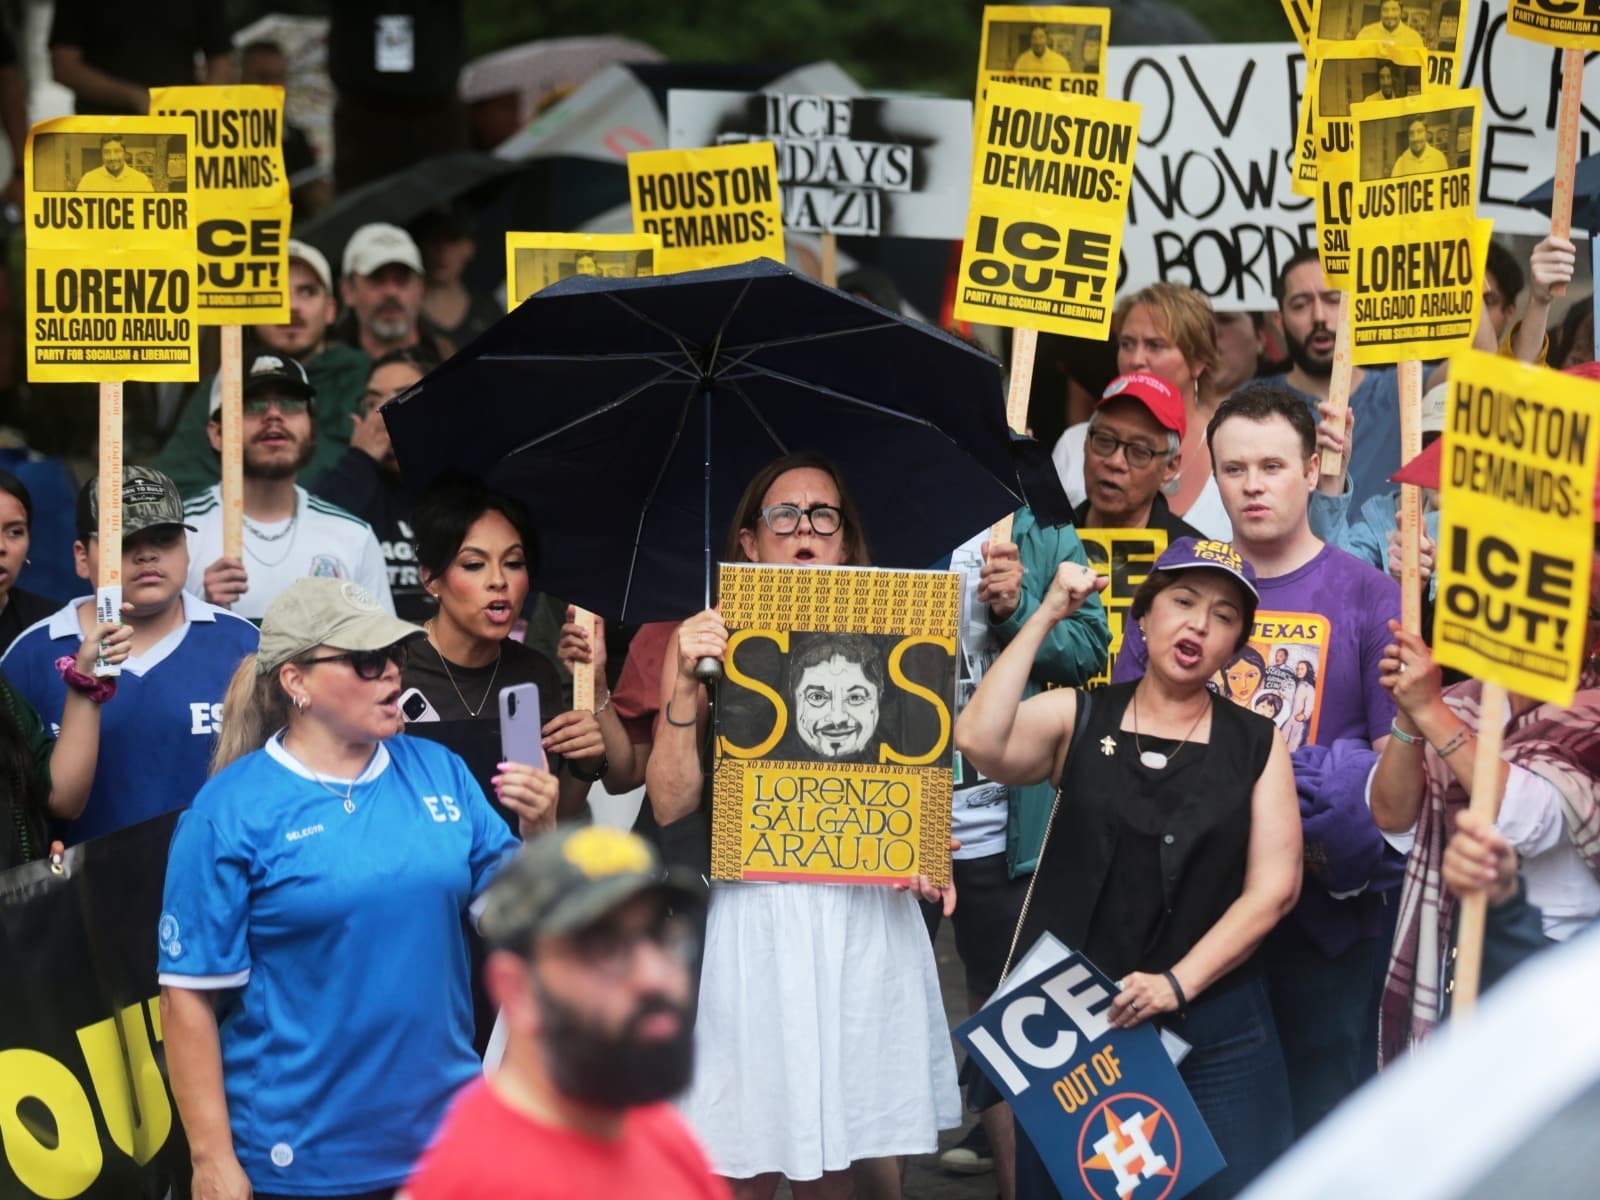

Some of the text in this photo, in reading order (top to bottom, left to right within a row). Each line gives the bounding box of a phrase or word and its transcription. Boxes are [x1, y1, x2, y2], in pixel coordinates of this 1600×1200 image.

[1514, 9, 1535, 23] PARTY
[1536, 14, 1549, 27] FOR
[1550, 17, 1592, 32] SOCIALISM
[1427, 55, 1454, 85] OR
[770, 95, 850, 136] ICE
[988, 105, 1132, 165] HOUSTON
[195, 155, 280, 190] MANDS:
[719, 138, 908, 185] DAYS
[983, 152, 1122, 203] DEMANDS:
[636, 165, 772, 212] HOUSTON
[1359, 180, 1434, 219] JUSTICE
[1440, 173, 1470, 210] FOR
[35, 197, 188, 230] JUSTICE FOR
[781, 188, 876, 230] AZI
[196, 218, 281, 257] CE
[643, 210, 774, 250] DEMANDS:
[975, 215, 1112, 271] ICE
[968, 258, 1107, 303] OUT!
[1356, 238, 1473, 293] LORENZO
[36, 268, 190, 314] LORENZO
[965, 289, 1104, 321] PARTY FOR SOCIALISM & LIBERATION
[1355, 291, 1473, 323] SALGADO ARAUJO
[35, 318, 190, 341] SALGADO ARAUJO
[37, 348, 189, 361] PARTY FOR SOCIALISM & LIBERATION
[1453, 380, 1591, 466] HOUSTON
[1451, 446, 1583, 520] DEMANDS:
[721, 574, 944, 591] XOX SOS XOX SOS XOX SOS XOX SOS XOX SOS XOX SOS
[1450, 526, 1575, 609] ICE
[720, 592, 944, 609] XOX SOS XOX SOS XOX SOS XOX SOS XOX SOS XOX SOS
[722, 601, 946, 619] SOS XOX SOS XOX SOS XOX SOS XOX SOS XOX SOS XOX
[723, 583, 947, 600] SOS XOX SOS XOX SOS XOX SOS XOX SOS XOX SOS XOX
[720, 611, 925, 627] XOX SOS XOX SOS XOX SOS XOX SOS XOX SOS XOX
[1250, 622, 1318, 639] TEXAS
[1445, 583, 1570, 651] OUT!
[746, 761, 920, 774] XO XO XO XO XO XO XO XO XO XO XO XO XOX
[424, 796, 461, 822] ES
[750, 804, 912, 837] SALGADO
[744, 833, 915, 872] ARAUJO
[968, 963, 1112, 1096] ICE
[0, 995, 172, 1200] OU
[1053, 1045, 1122, 1114] OUT OF
